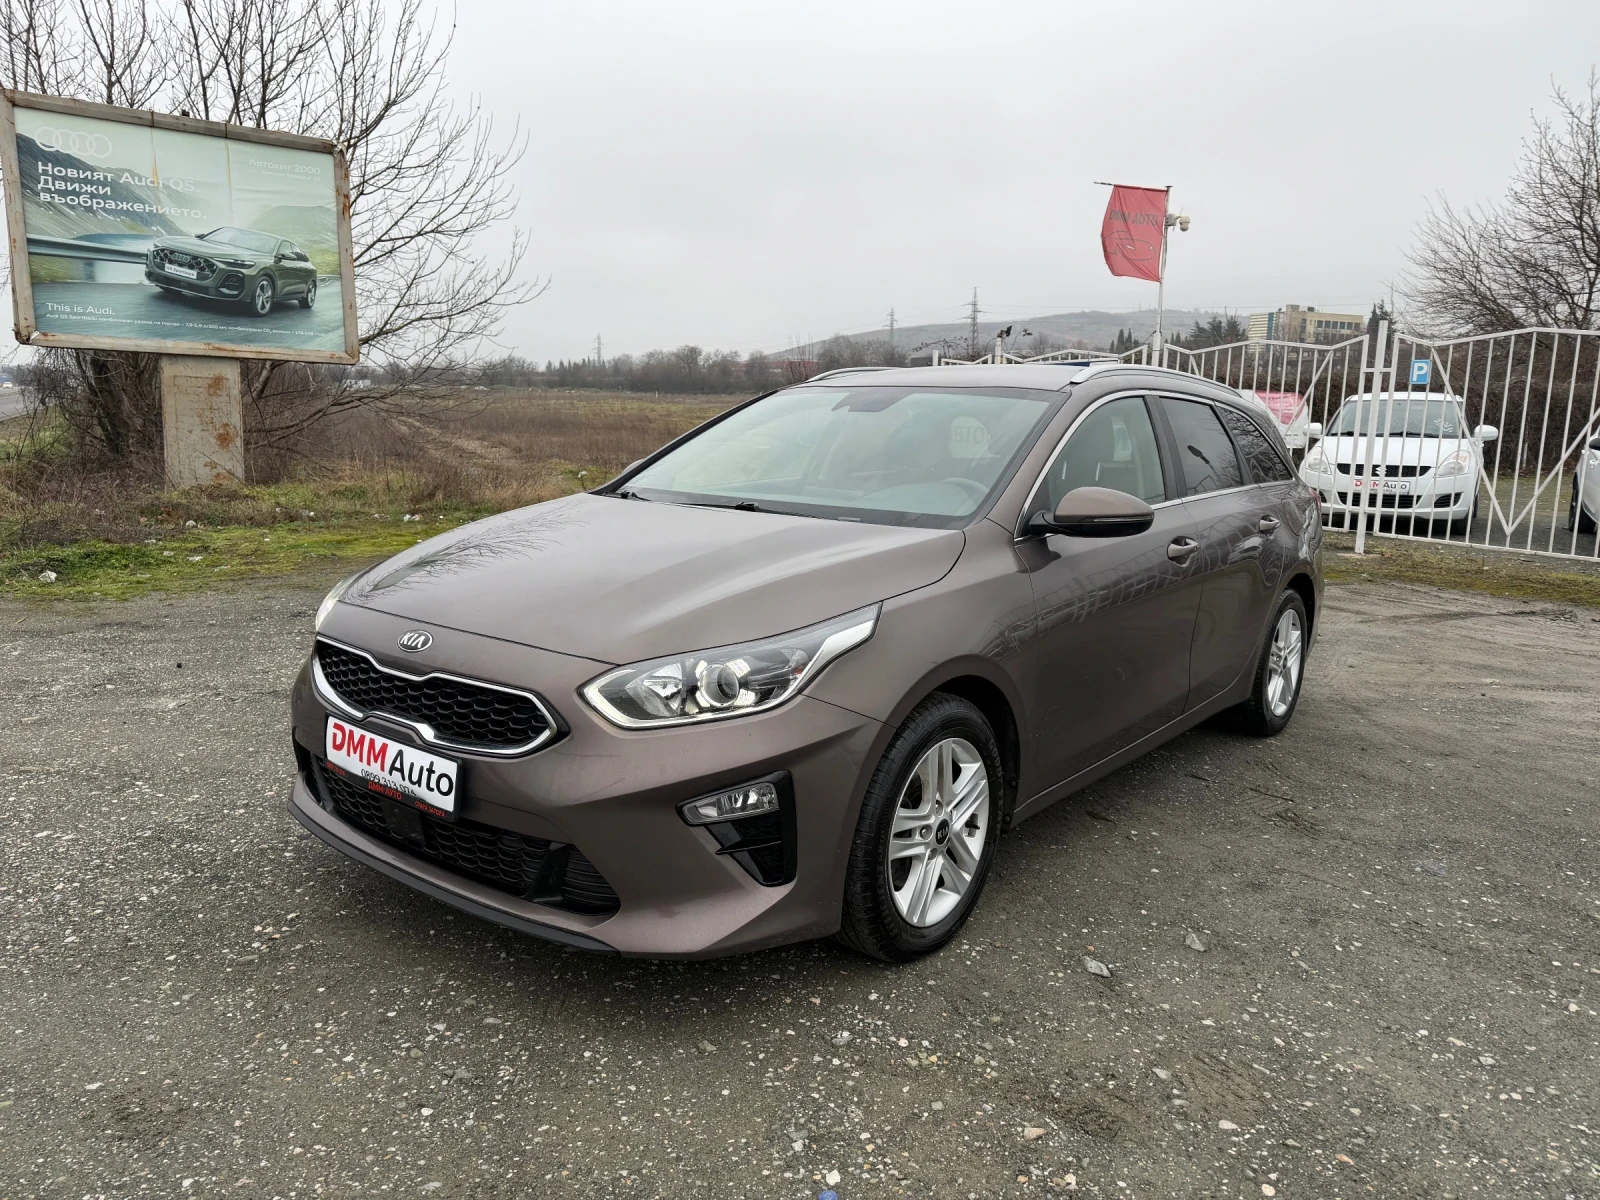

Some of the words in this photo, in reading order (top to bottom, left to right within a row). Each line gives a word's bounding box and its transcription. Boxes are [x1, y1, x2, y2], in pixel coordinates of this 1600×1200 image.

[249, 158, 292, 171] Автохит
[294, 164, 321, 175] 2000
[37, 175, 111, 196] Движи
[38, 161, 114, 182] Новият
[120, 172, 163, 188] Audi
[169, 178, 201, 193] Q5.
[39, 192, 207, 219] въображението.
[45, 302, 71, 312] This
[74, 304, 84, 313] is
[86, 305, 115, 315] Audi.
[1412, 362, 1428, 382] P
[400, 632, 426, 648] KIA
[381, 776, 399, 790] 313
[937, 826, 949, 840] KIA
